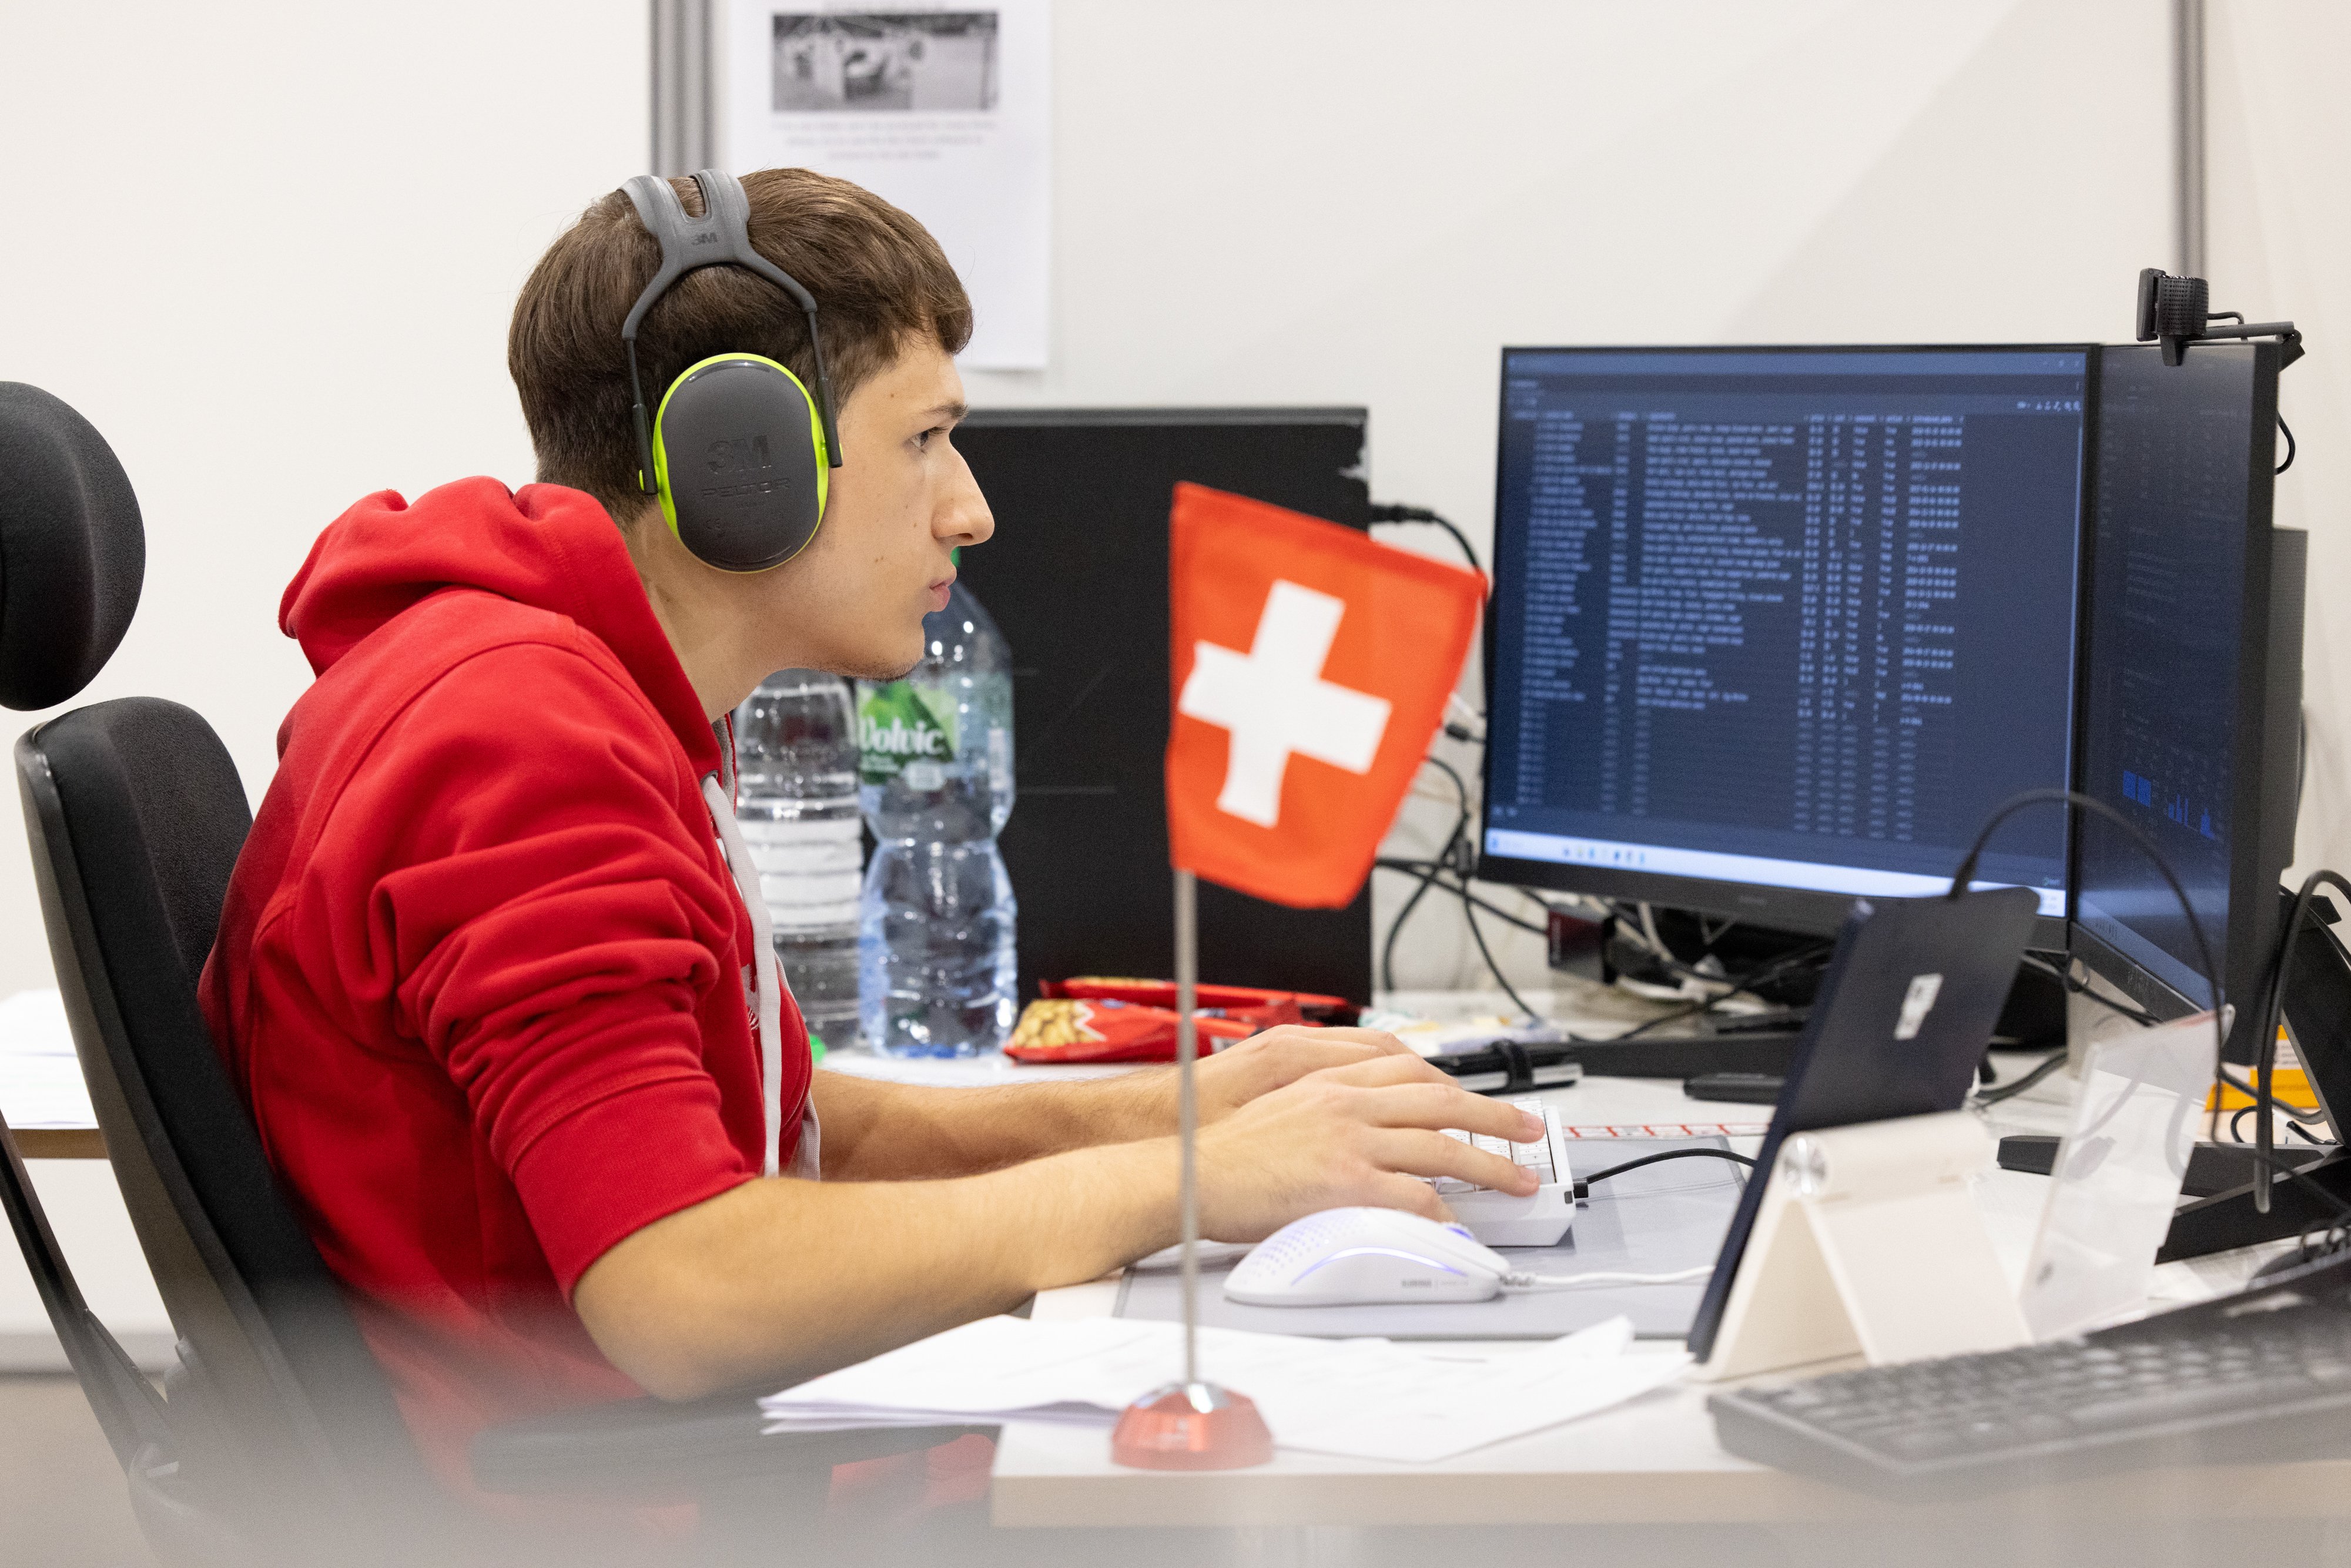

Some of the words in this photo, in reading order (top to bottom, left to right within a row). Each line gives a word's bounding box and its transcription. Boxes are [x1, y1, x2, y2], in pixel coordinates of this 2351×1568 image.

[691, 232, 718, 246] 3M
[705, 435, 772, 475] 3M
[701, 477, 791, 501] PELTOR
[859, 716, 945, 755] Volvic
